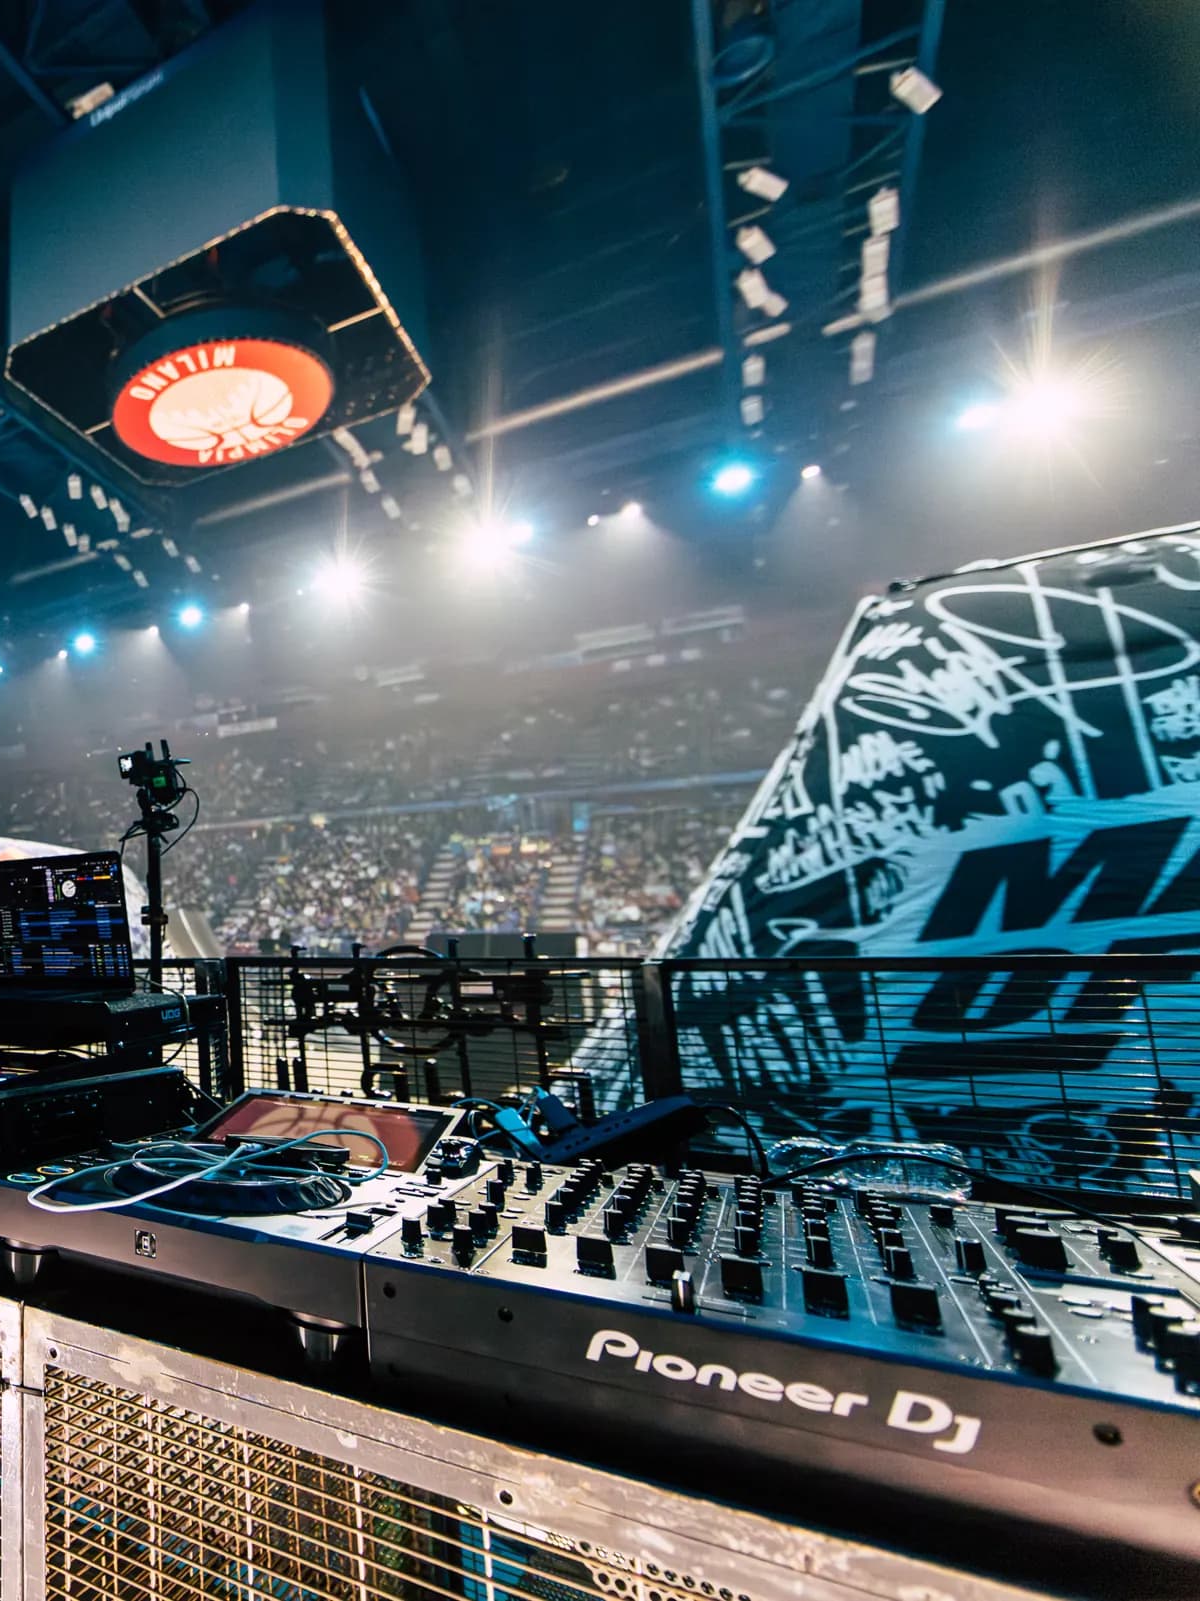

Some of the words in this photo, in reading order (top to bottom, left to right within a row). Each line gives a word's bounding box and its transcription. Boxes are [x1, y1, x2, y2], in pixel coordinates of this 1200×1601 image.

[129, 345, 237, 401] MILANO
[198, 416, 310, 464] OLIMPIA
[161, 1008, 181, 1020] UDG
[585, 1329, 869, 1417] Pioneer
